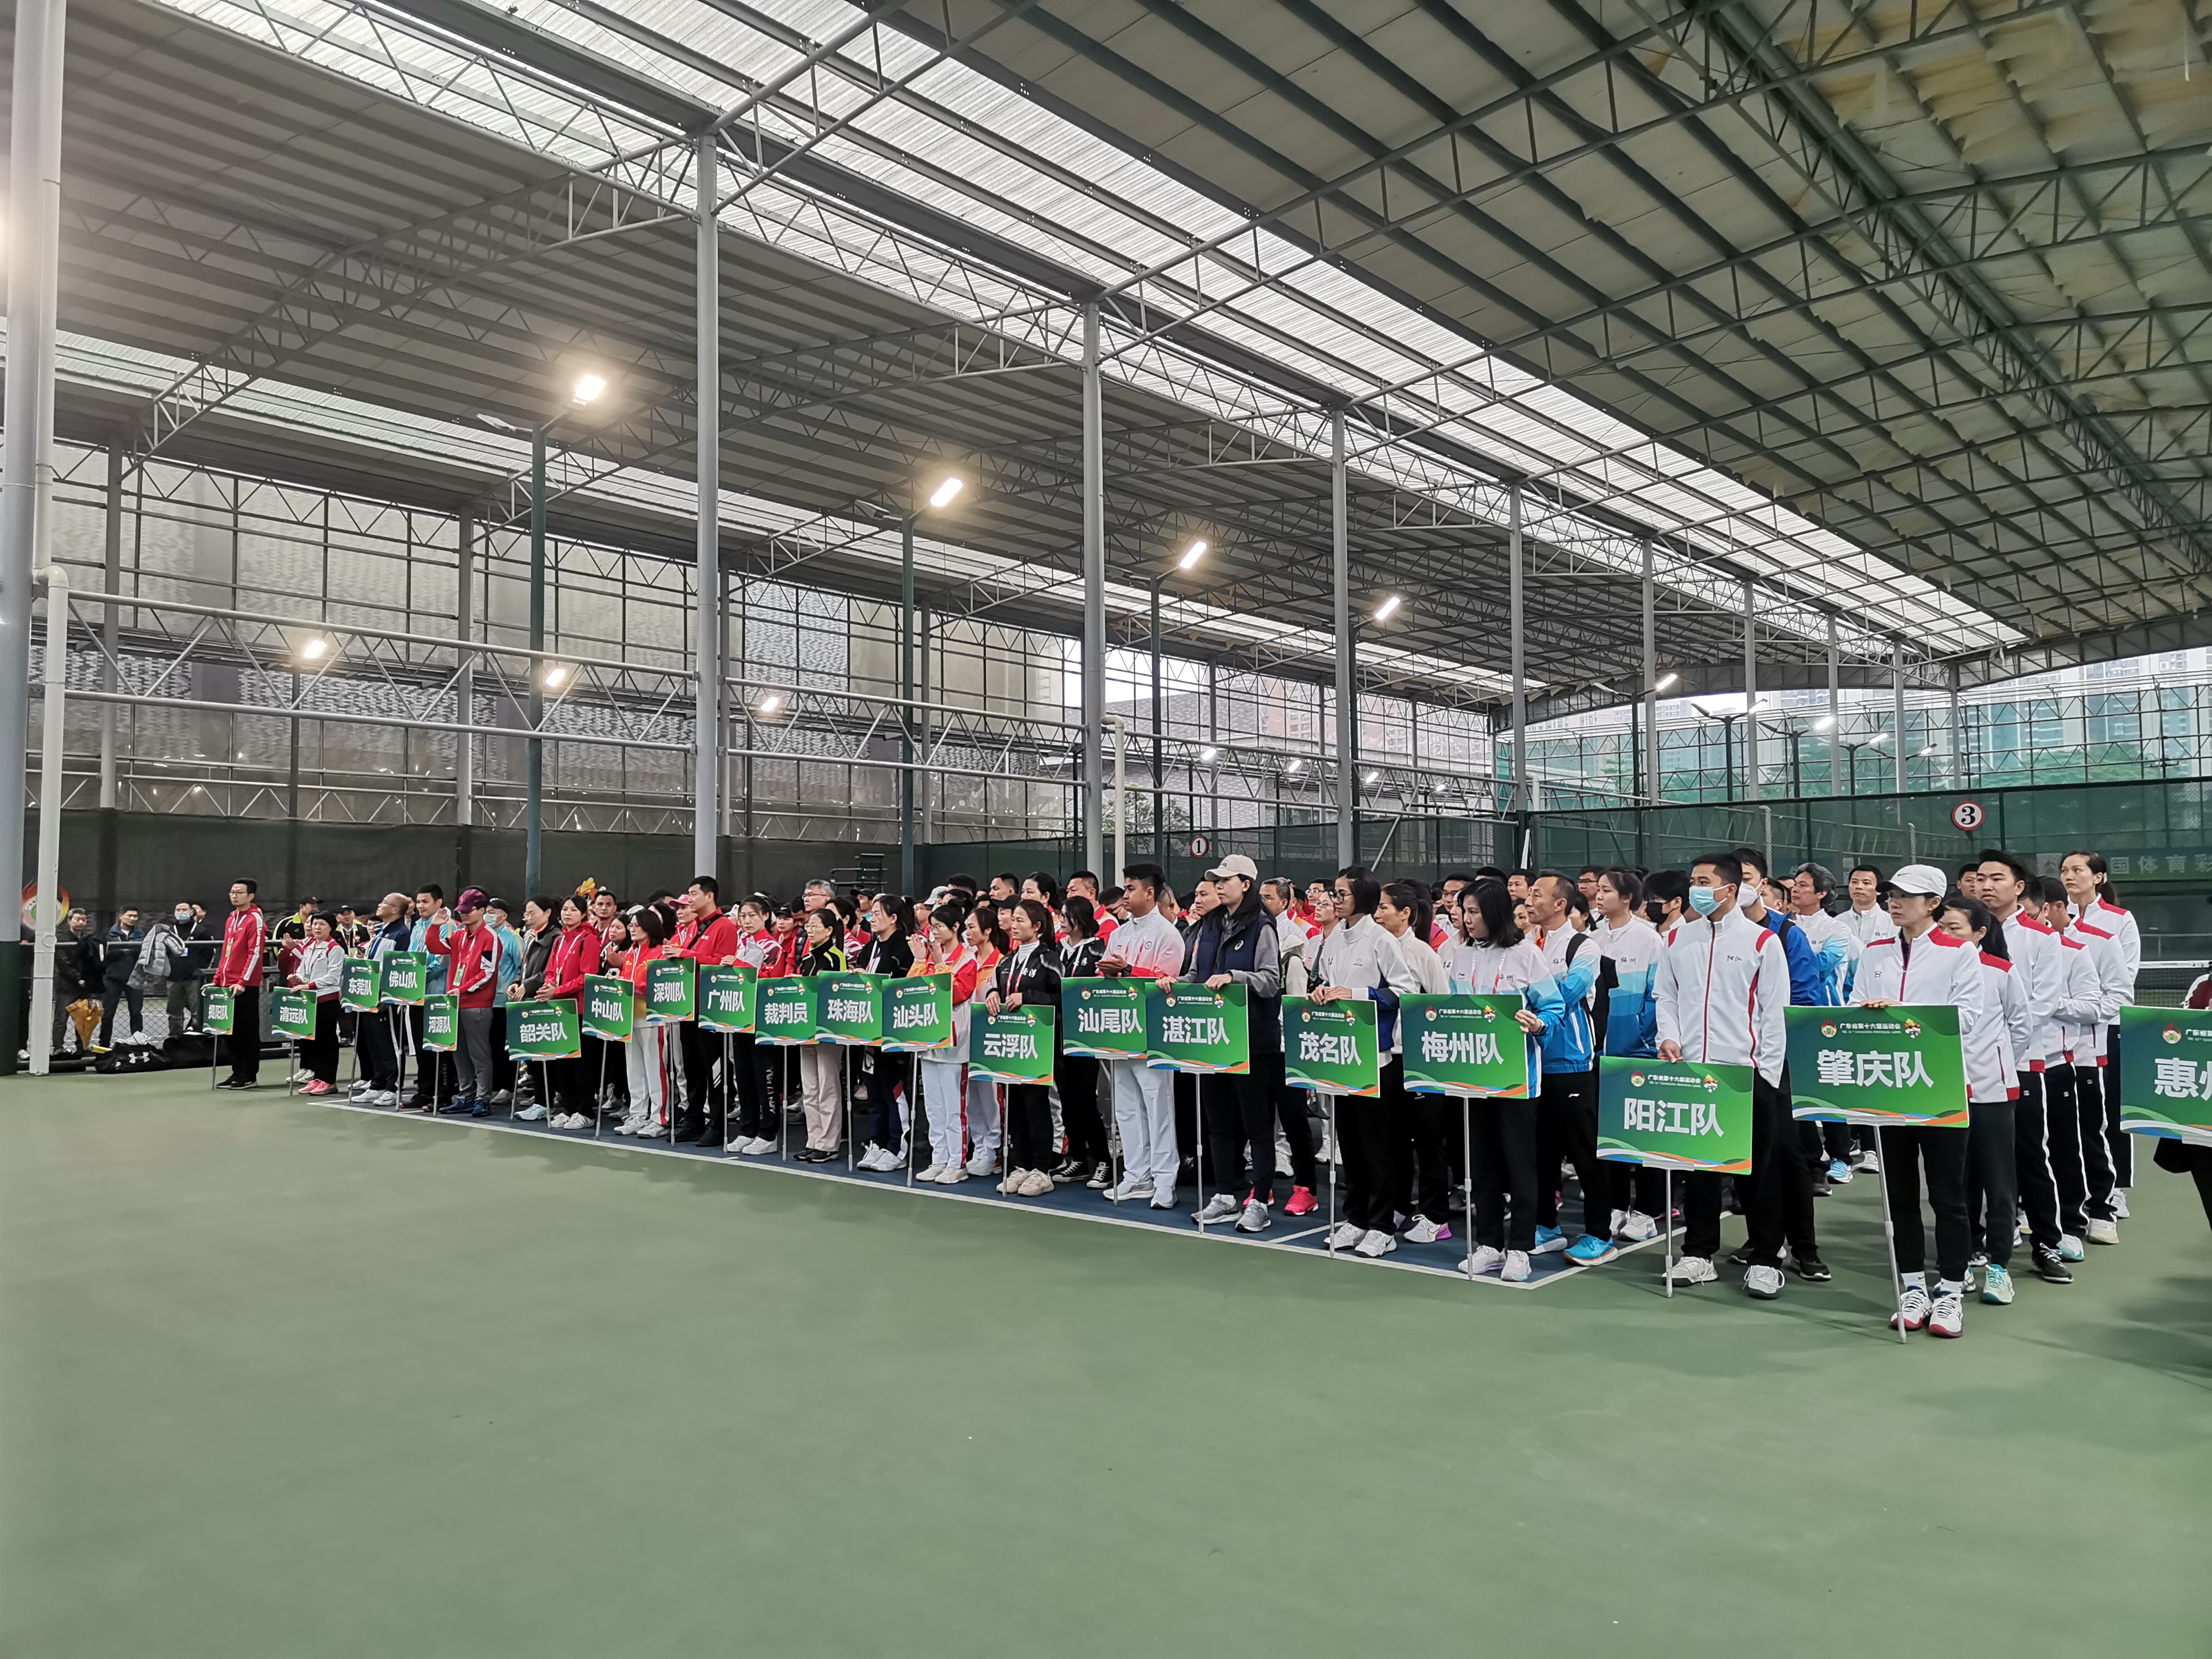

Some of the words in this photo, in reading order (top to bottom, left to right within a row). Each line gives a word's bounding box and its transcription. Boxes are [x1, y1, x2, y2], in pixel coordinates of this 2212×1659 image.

[1960, 806, 1975, 825] 3
[1196, 840, 1202, 853] 1
[348, 977, 372, 996] 东莞队
[389, 970, 418, 989] 佛山队
[653, 981, 686, 1003] 深圳队
[707, 989, 745, 1012] 广州队
[208, 1004, 228, 1020] 揭阳队
[279, 1005, 308, 1025] 清远队
[591, 998, 624, 1022] 中山队
[764, 1001, 808, 1025] 裁判员
[827, 998, 874, 1024] 珠海队
[893, 1002, 939, 1029] 汕头队
[1078, 1007, 1143, 1034] 汕尾队
[428, 1015, 451, 1034] 河源队
[519, 1021, 568, 1044] 韶关队
[1162, 1015, 1230, 1045] 湛江队
[983, 1033, 1039, 1060] 云浮队
[1298, 1031, 1362, 1066] 茂名队
[1421, 1030, 1504, 1065] 梅州队
[1647, 1074, 1702, 1084] 广东省第十六届运动会
[1817, 1049, 1934, 1088] 肇庆队
[1624, 1097, 1724, 1138] 阳江队
